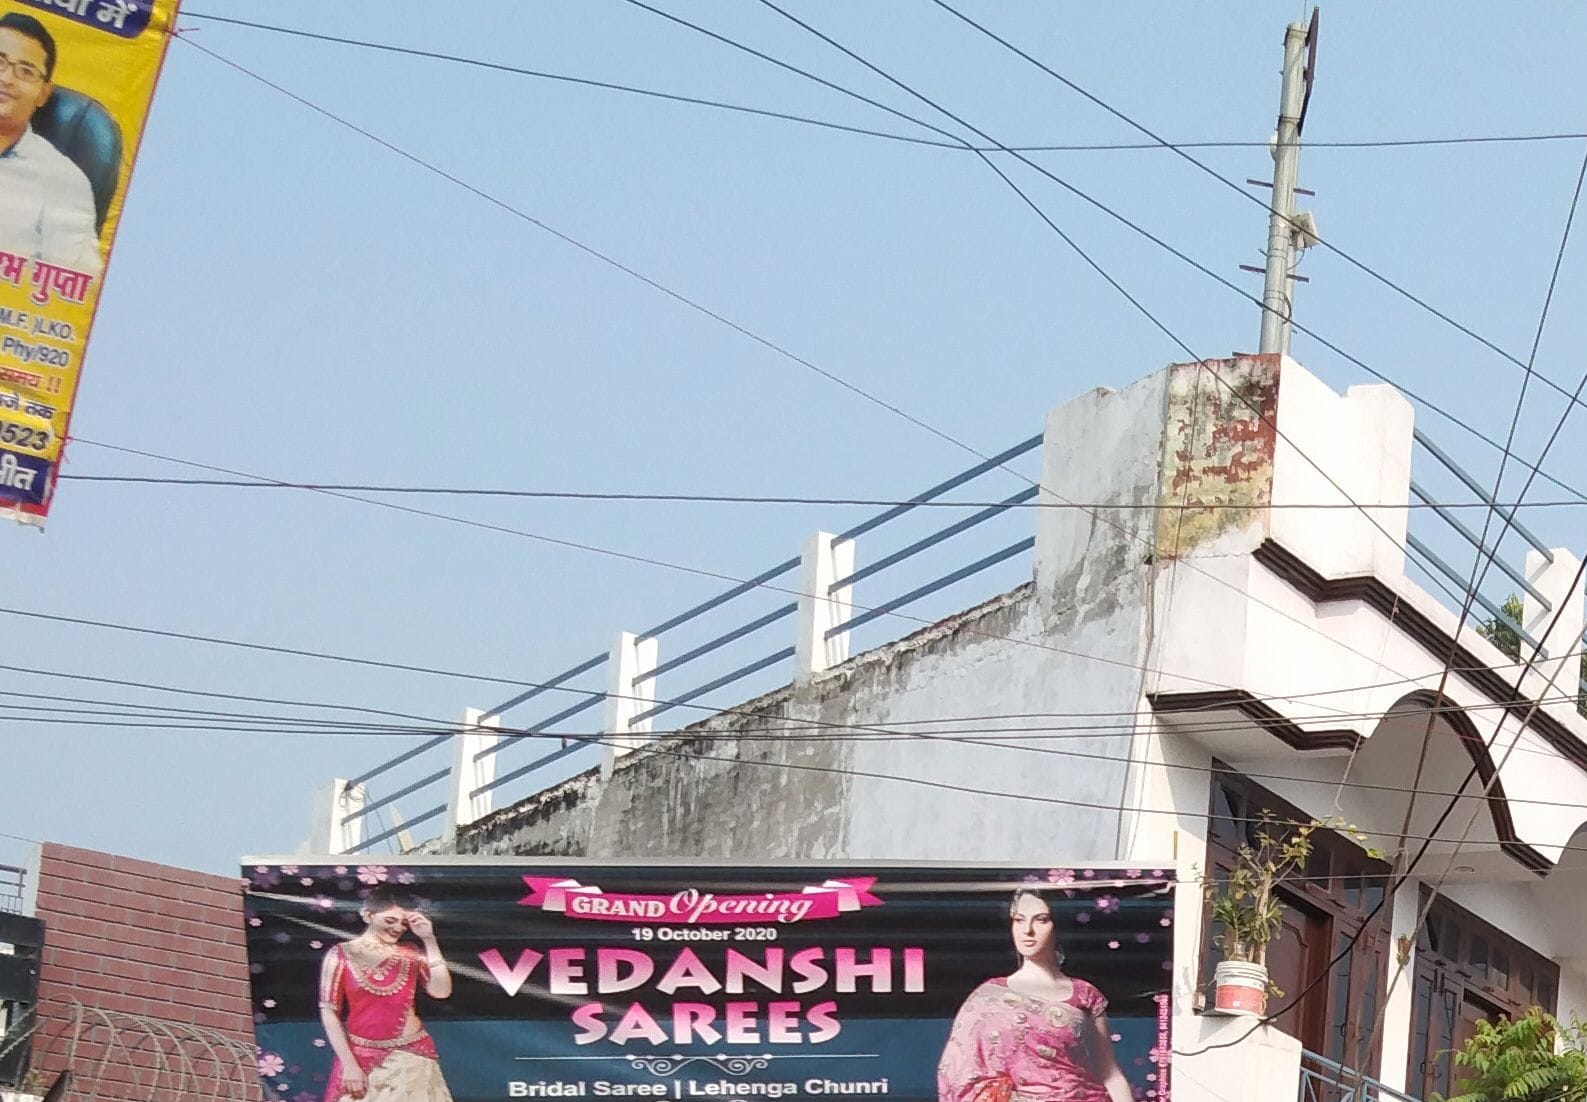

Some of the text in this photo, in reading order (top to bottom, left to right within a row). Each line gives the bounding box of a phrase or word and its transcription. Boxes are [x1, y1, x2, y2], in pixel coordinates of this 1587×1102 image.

[31, 260, 94, 303] गुप्ता
[0, 422, 50, 451] 523
[572, 888, 814, 923] GRAND Opening
[631, 927, 778, 941] 19 October 2020
[478, 946, 926, 998] VEDANSHI
[570, 1001, 841, 1046] SAREES
[508, 1080, 585, 1098] Bridal
[593, 1080, 668, 1097] Saree
[689, 1079, 797, 1099] Lehenga
[804, 1078, 889, 1095] Chunri
